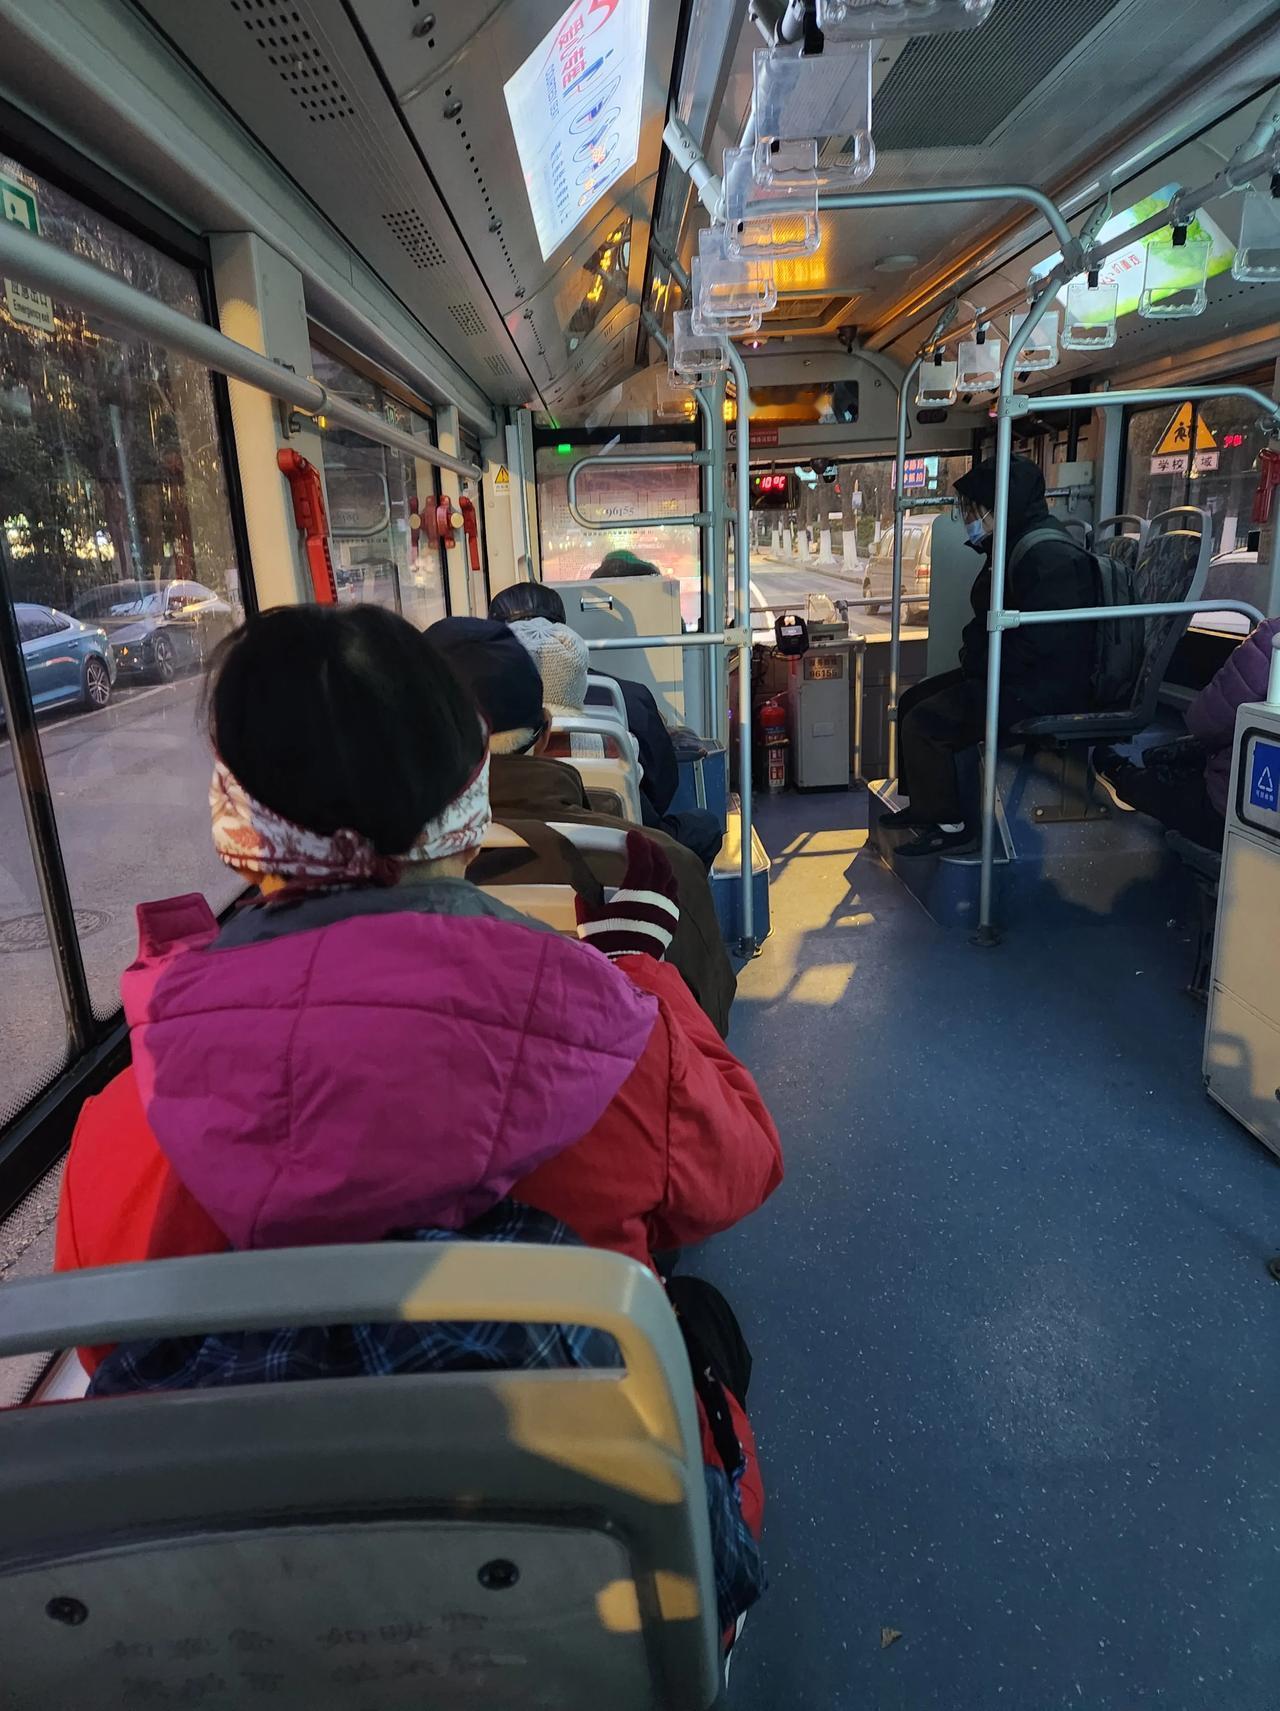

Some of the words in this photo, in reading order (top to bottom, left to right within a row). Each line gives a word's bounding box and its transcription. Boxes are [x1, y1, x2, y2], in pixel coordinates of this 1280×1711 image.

[558, 15, 586, 89] 爱心专座
[1158, 456, 1212, 471] 学校域
